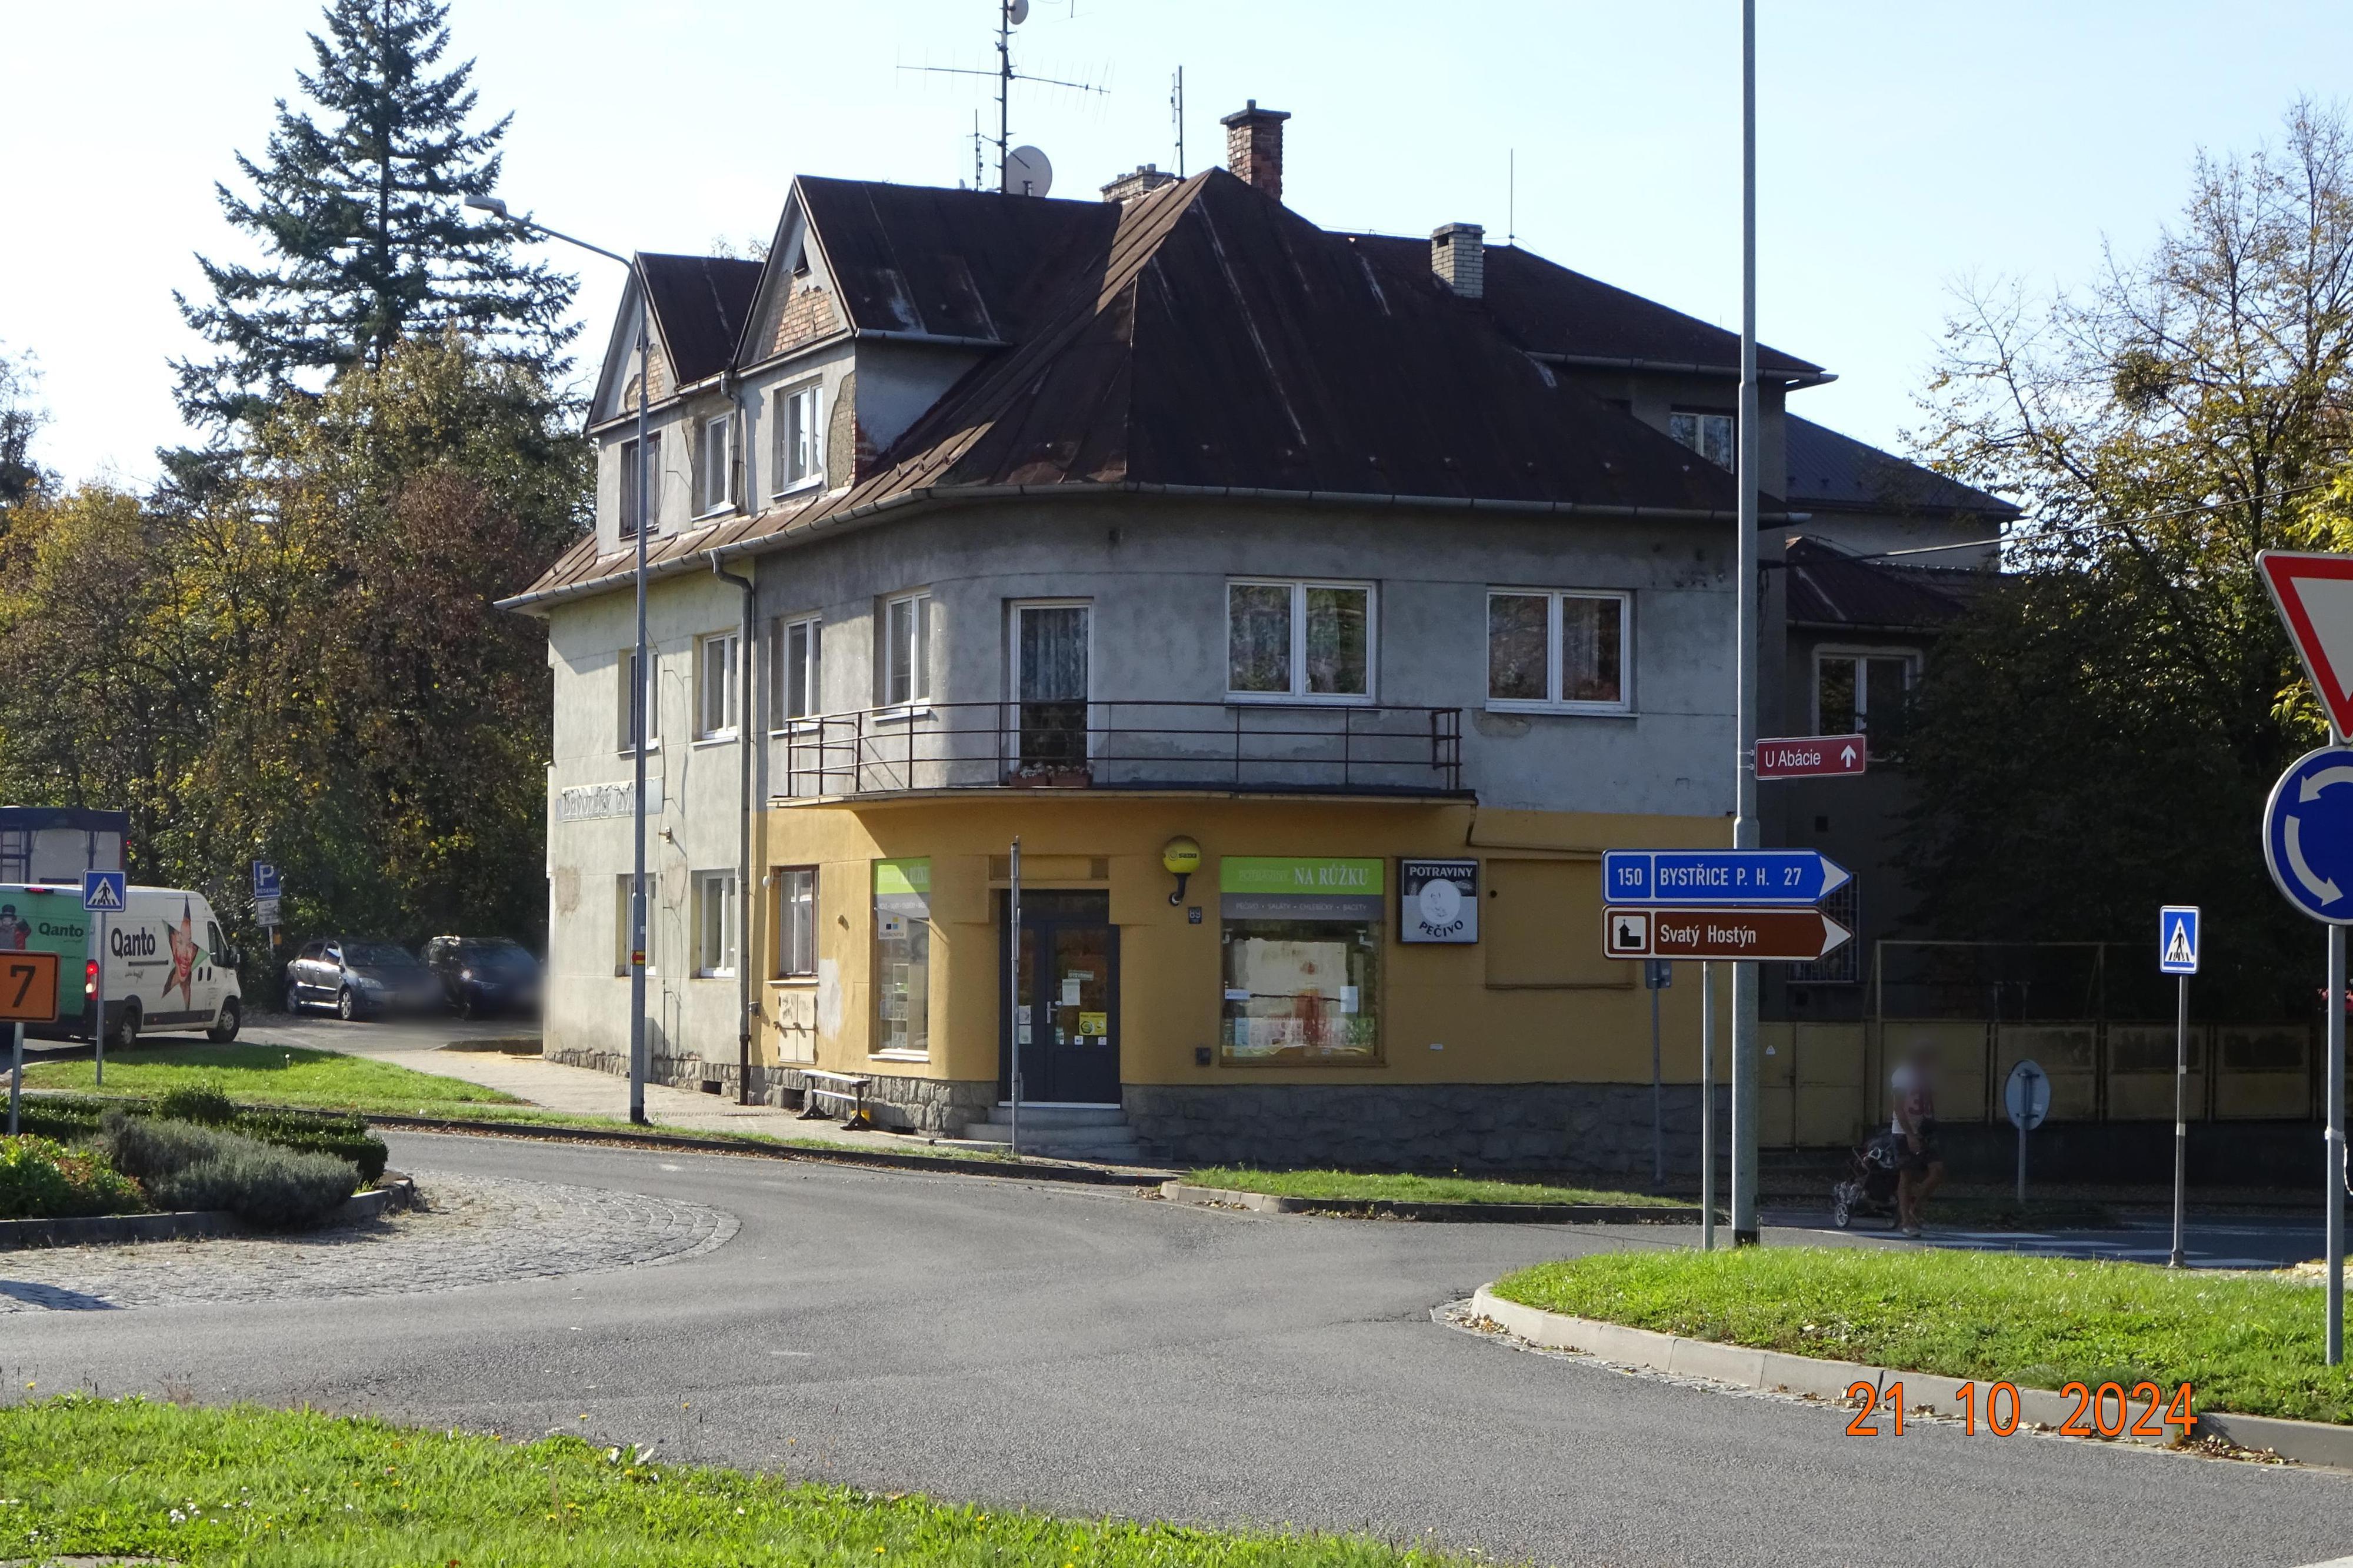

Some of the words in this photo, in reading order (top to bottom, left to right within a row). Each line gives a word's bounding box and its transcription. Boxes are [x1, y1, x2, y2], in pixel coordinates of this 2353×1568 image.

[1765, 750, 1775, 768] U
[1778, 749, 1821, 767] Abácie
[1294, 867, 1314, 885] NA
[1319, 863, 1369, 886] RŮŽKU
[1409, 866, 1473, 877] POTRAVINY
[1618, 868, 1643, 886] 150
[1660, 863, 1729, 886] BYSTŘICE
[1737, 868, 1748, 886] P.
[1757, 868, 1769, 886] H.
[1784, 868, 1802, 886] 27
[38, 922, 84, 937] Qanto
[1419, 920, 1464, 937] PEČIVO
[1661, 924, 1700, 947] Svatý
[1708, 925, 1757, 948] Hostýn
[111, 926, 156, 959] Qanto
[10, 965, 36, 1007] 7
